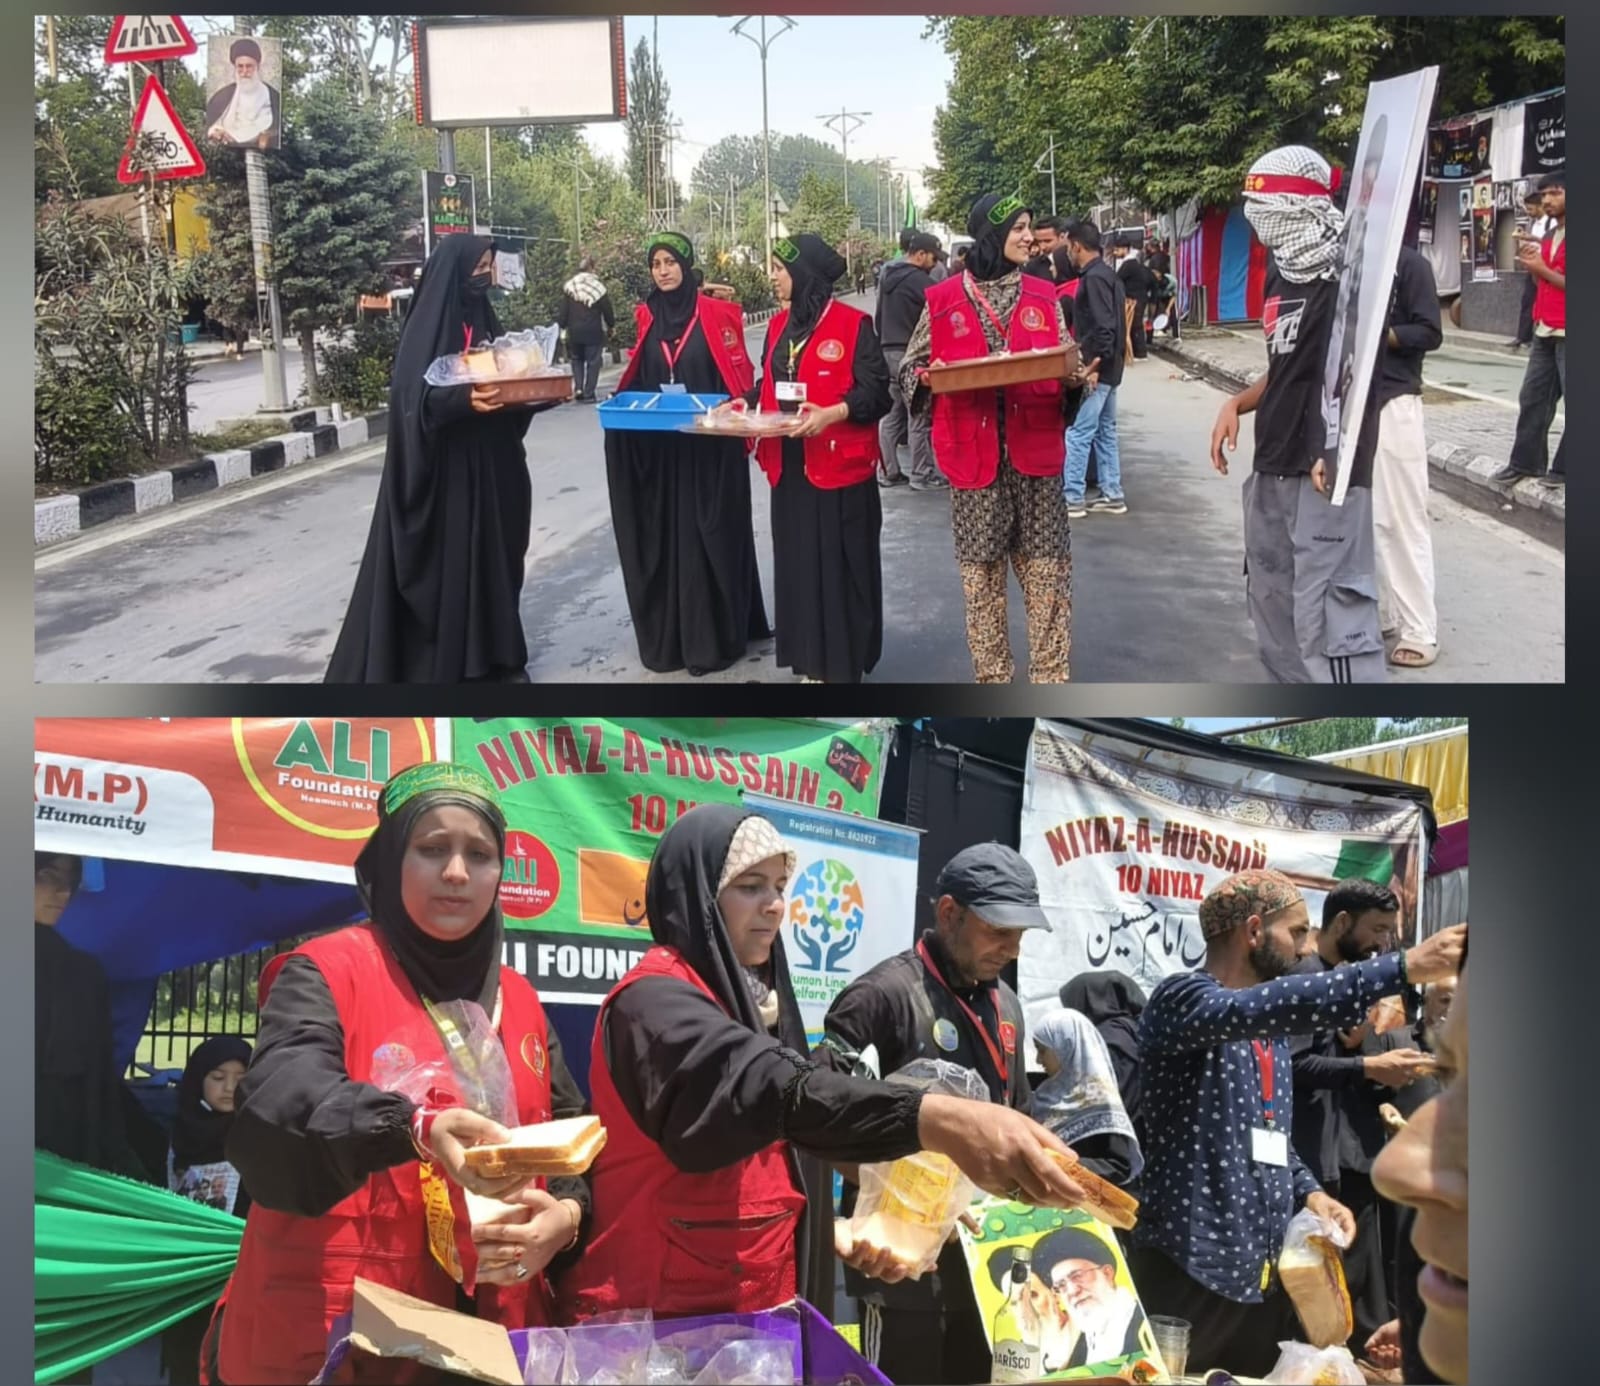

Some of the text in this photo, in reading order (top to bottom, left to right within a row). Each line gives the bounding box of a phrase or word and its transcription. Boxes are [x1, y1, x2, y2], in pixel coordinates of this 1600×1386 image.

[273, 718, 390, 784] ALI
[476, 724, 820, 805] NIYAZ-A-HUSSAIN
[278, 771, 380, 800] Foundatio
[36, 804, 147, 835] Humanity
[627, 792, 668, 835] 10
[789, 818, 833, 836] Registration
[1044, 816, 1268, 873] NIYAZ-A-HUSSAIN
[502, 855, 538, 886] ALI
[1115, 863, 1206, 901] 10 NIYAZ
[499, 885, 551, 898] undation
[791, 973, 822, 987] uman
[793, 985, 828, 1001] elfare
